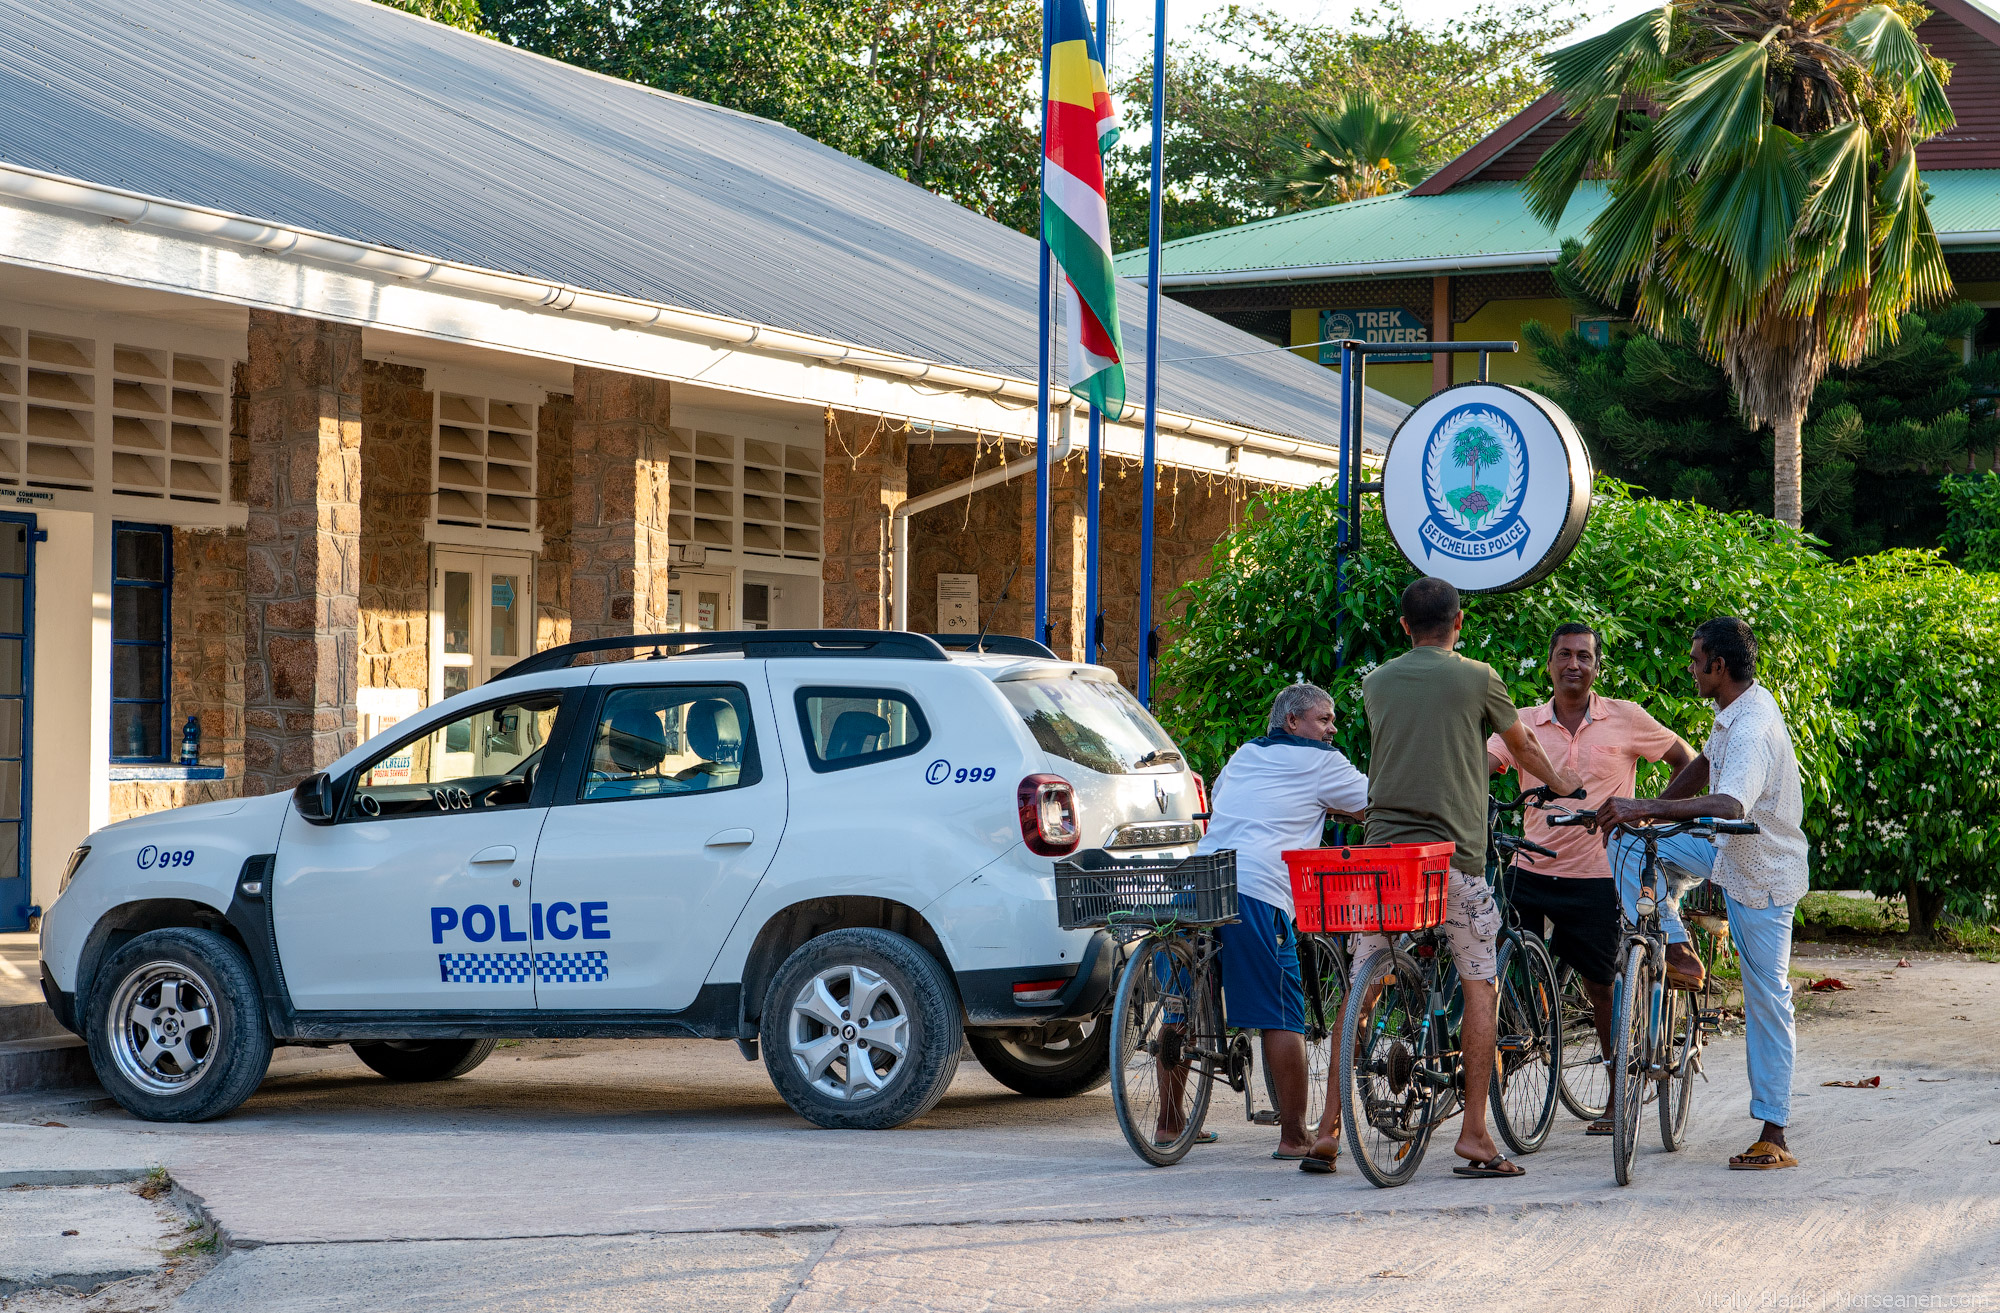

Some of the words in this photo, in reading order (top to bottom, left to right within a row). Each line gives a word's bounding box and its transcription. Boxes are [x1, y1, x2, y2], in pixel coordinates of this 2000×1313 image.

[1356, 311, 1401, 328] TREK
[1366, 328, 1428, 343] DIVERS
[1424, 524, 1487, 556] SEYCHELLES
[1488, 523, 1525, 554] POLICE
[954, 767, 996, 784] 999
[158, 850, 195, 868] 999
[430, 901, 611, 944] POLICE
